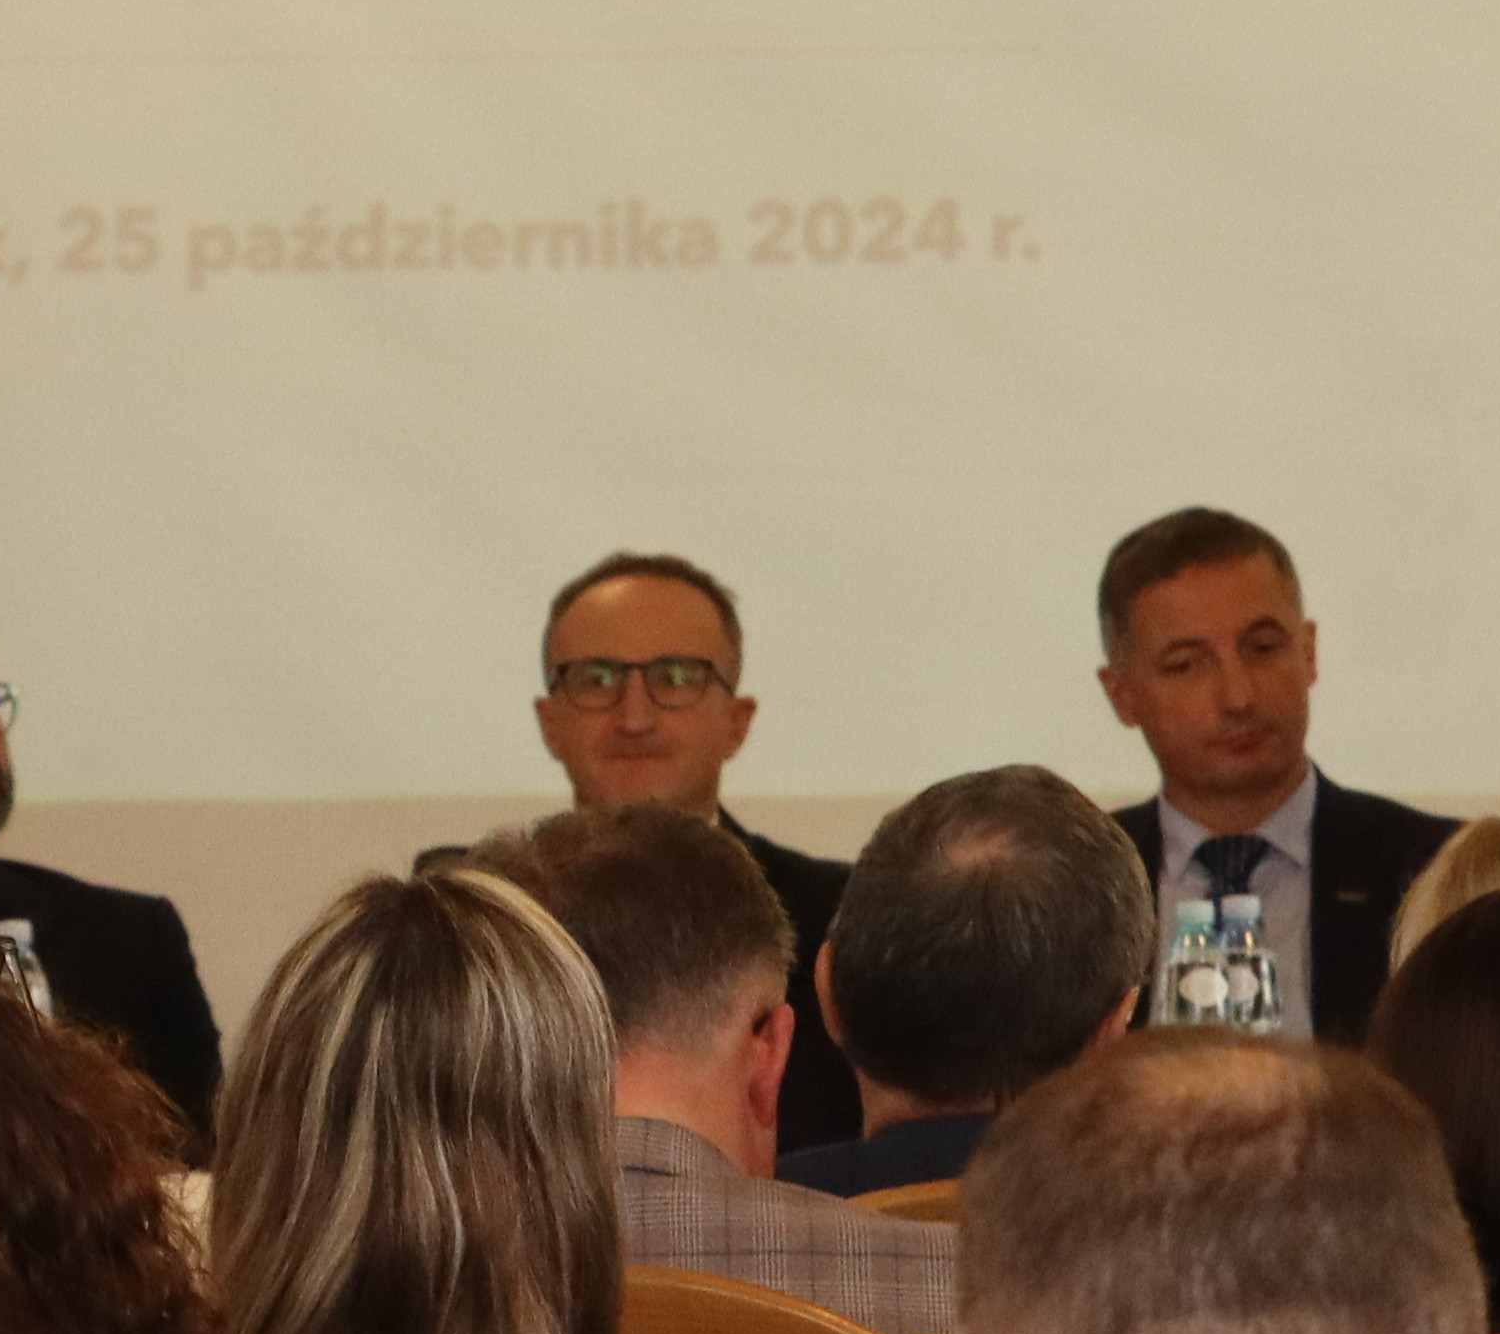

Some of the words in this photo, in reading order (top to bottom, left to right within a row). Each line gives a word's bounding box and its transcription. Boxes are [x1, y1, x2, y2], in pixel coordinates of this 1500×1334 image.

[54, 207, 159, 276] 25
[186, 199, 722, 292] października
[745, 199, 965, 268] 2024
[986, 210, 1044, 266] r.
